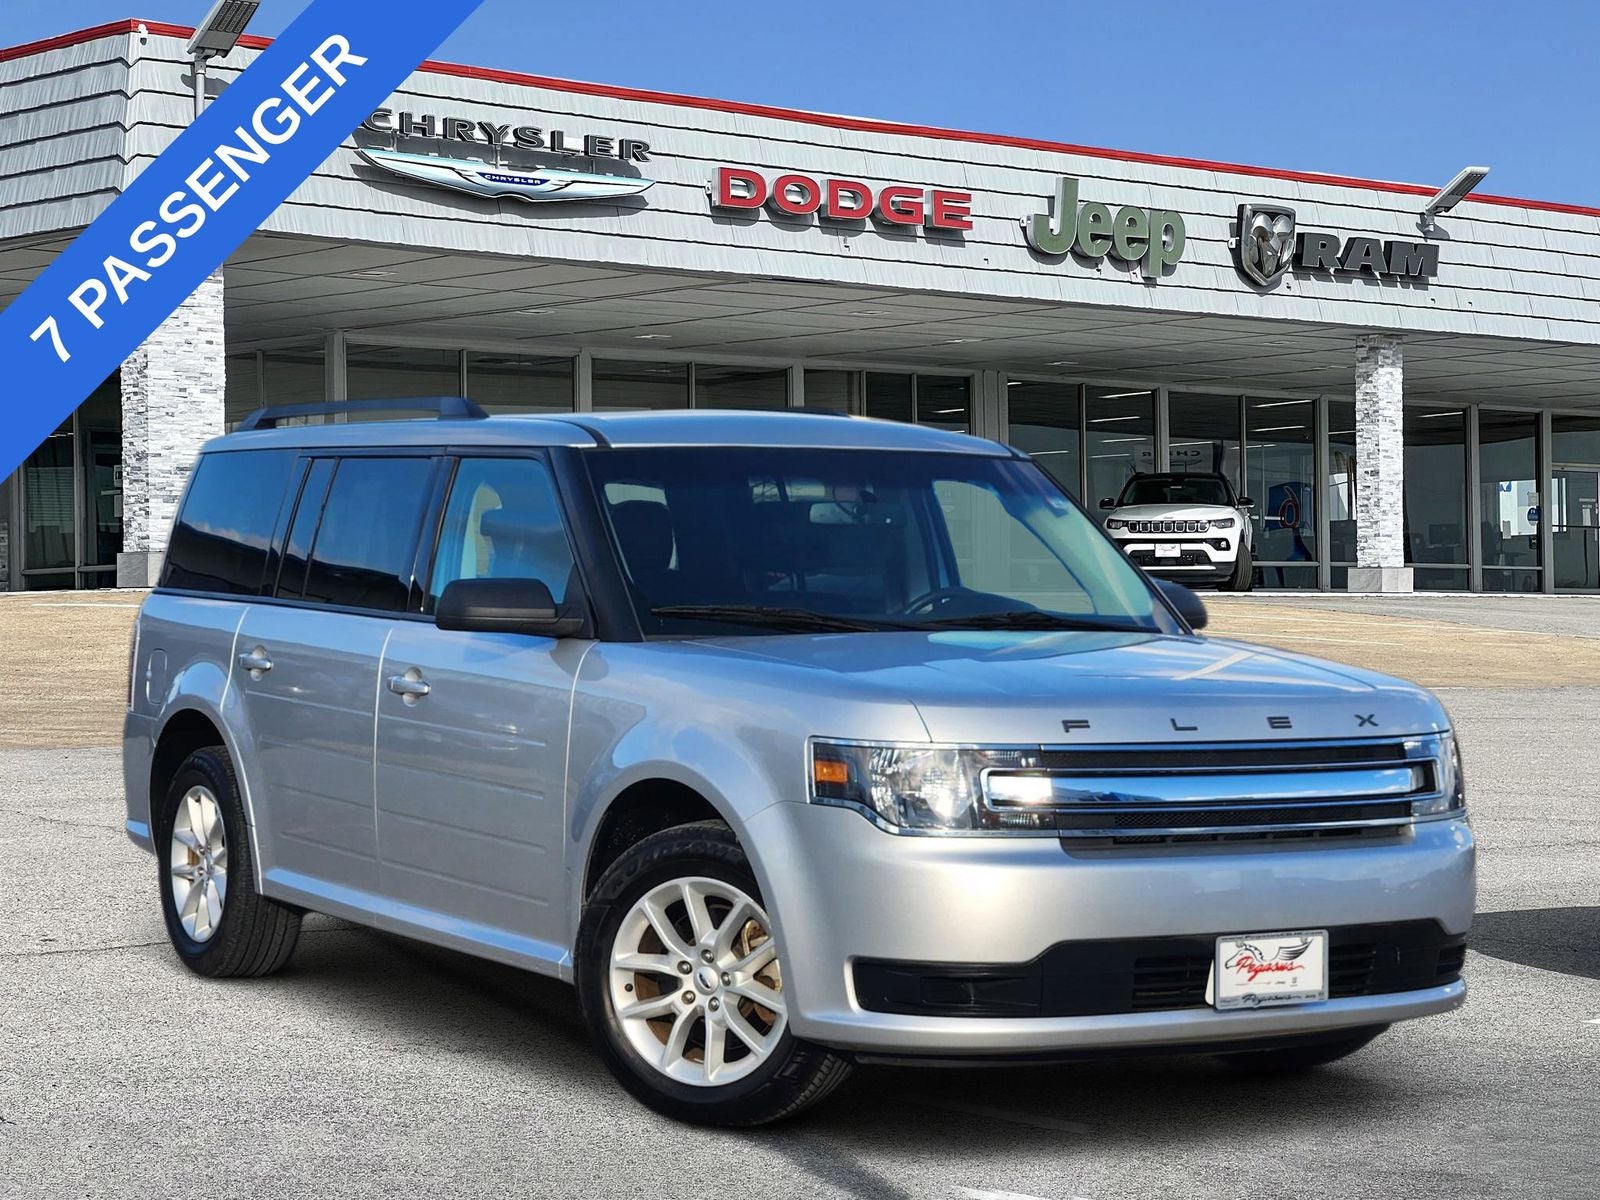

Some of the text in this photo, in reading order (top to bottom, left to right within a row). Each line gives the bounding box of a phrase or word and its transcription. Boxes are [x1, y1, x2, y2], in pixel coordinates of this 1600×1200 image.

[361, 108, 651, 162] CHRYSLER
[484, 174, 541, 184] CHRYSLER
[712, 167, 974, 231] DODGE
[1027, 177, 1186, 278] Jeep
[1296, 232, 1440, 277] RAM
[1061, 713, 1379, 733] FLEX
[1236, 956, 1305, 982] Pegasus
